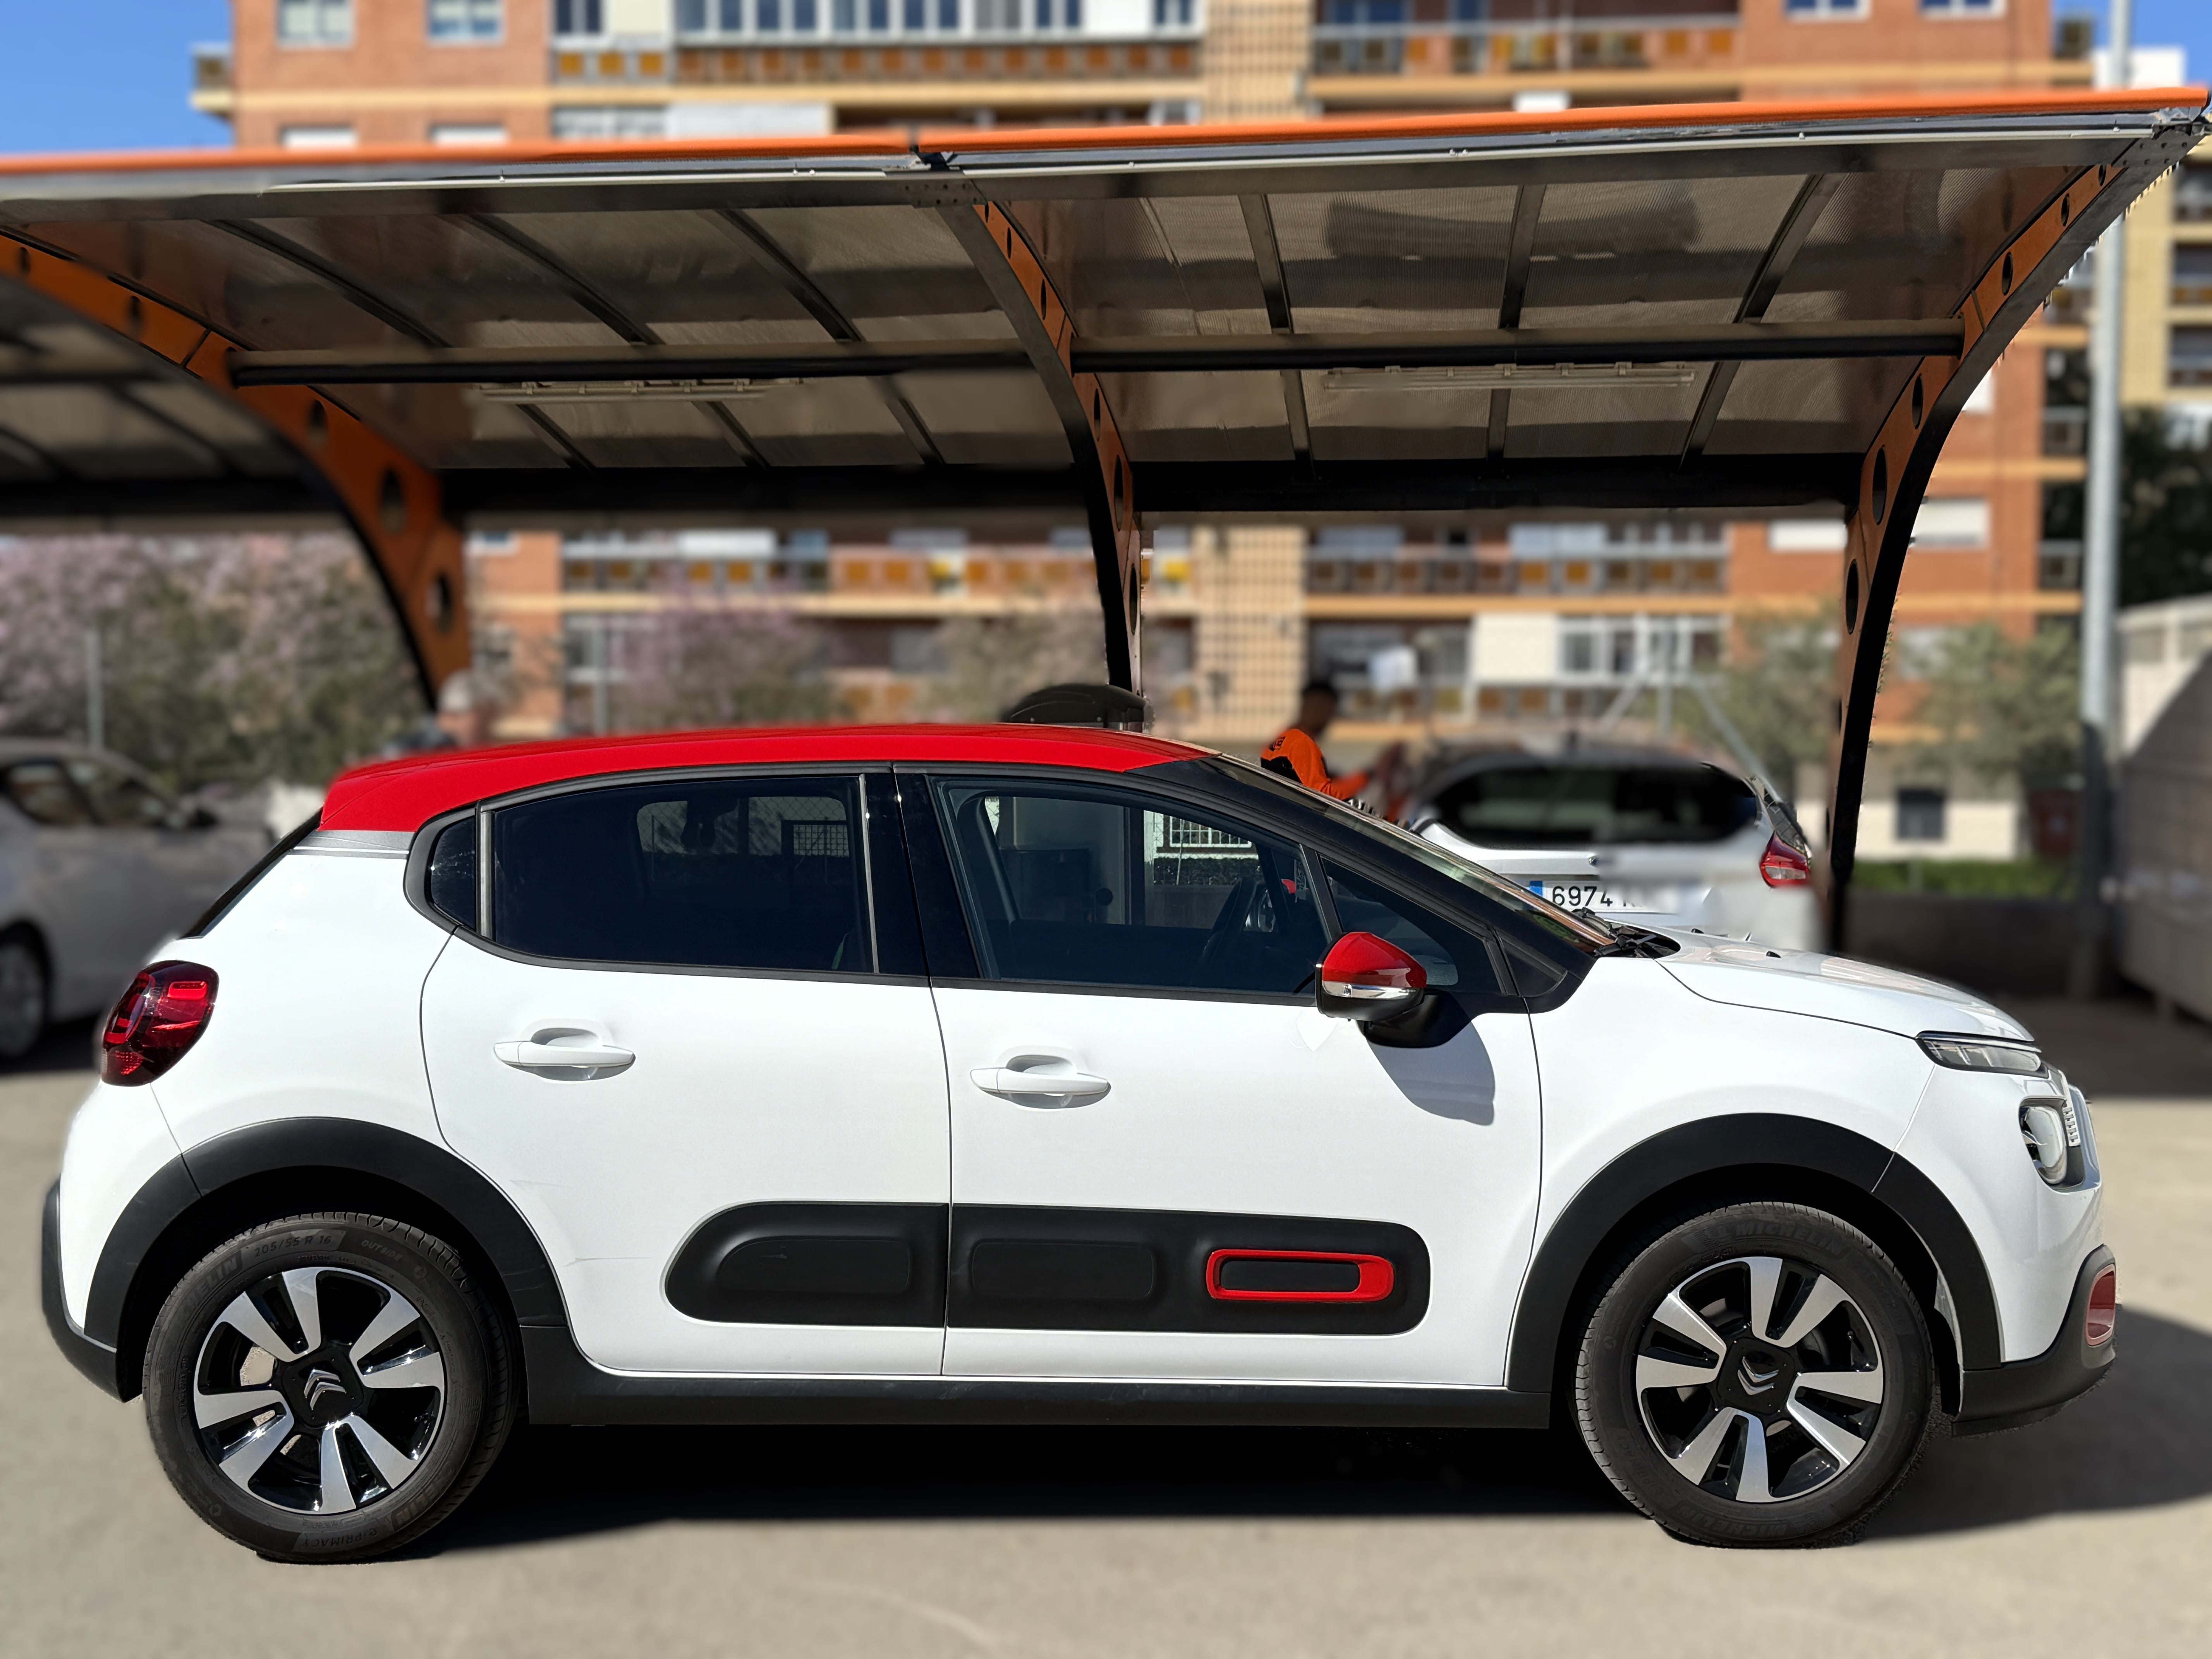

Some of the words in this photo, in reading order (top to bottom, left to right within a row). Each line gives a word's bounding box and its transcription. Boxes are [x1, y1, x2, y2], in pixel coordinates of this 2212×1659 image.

[1552, 886, 1613, 907] 6974
[254, 1236, 300, 1257] 205/55
[304, 1236, 314, 1245] R
[319, 1235, 331, 1245] 16
[361, 1239, 403, 1261] OUTSIDE
[1735, 1223, 1843, 1256] MICHELIN
